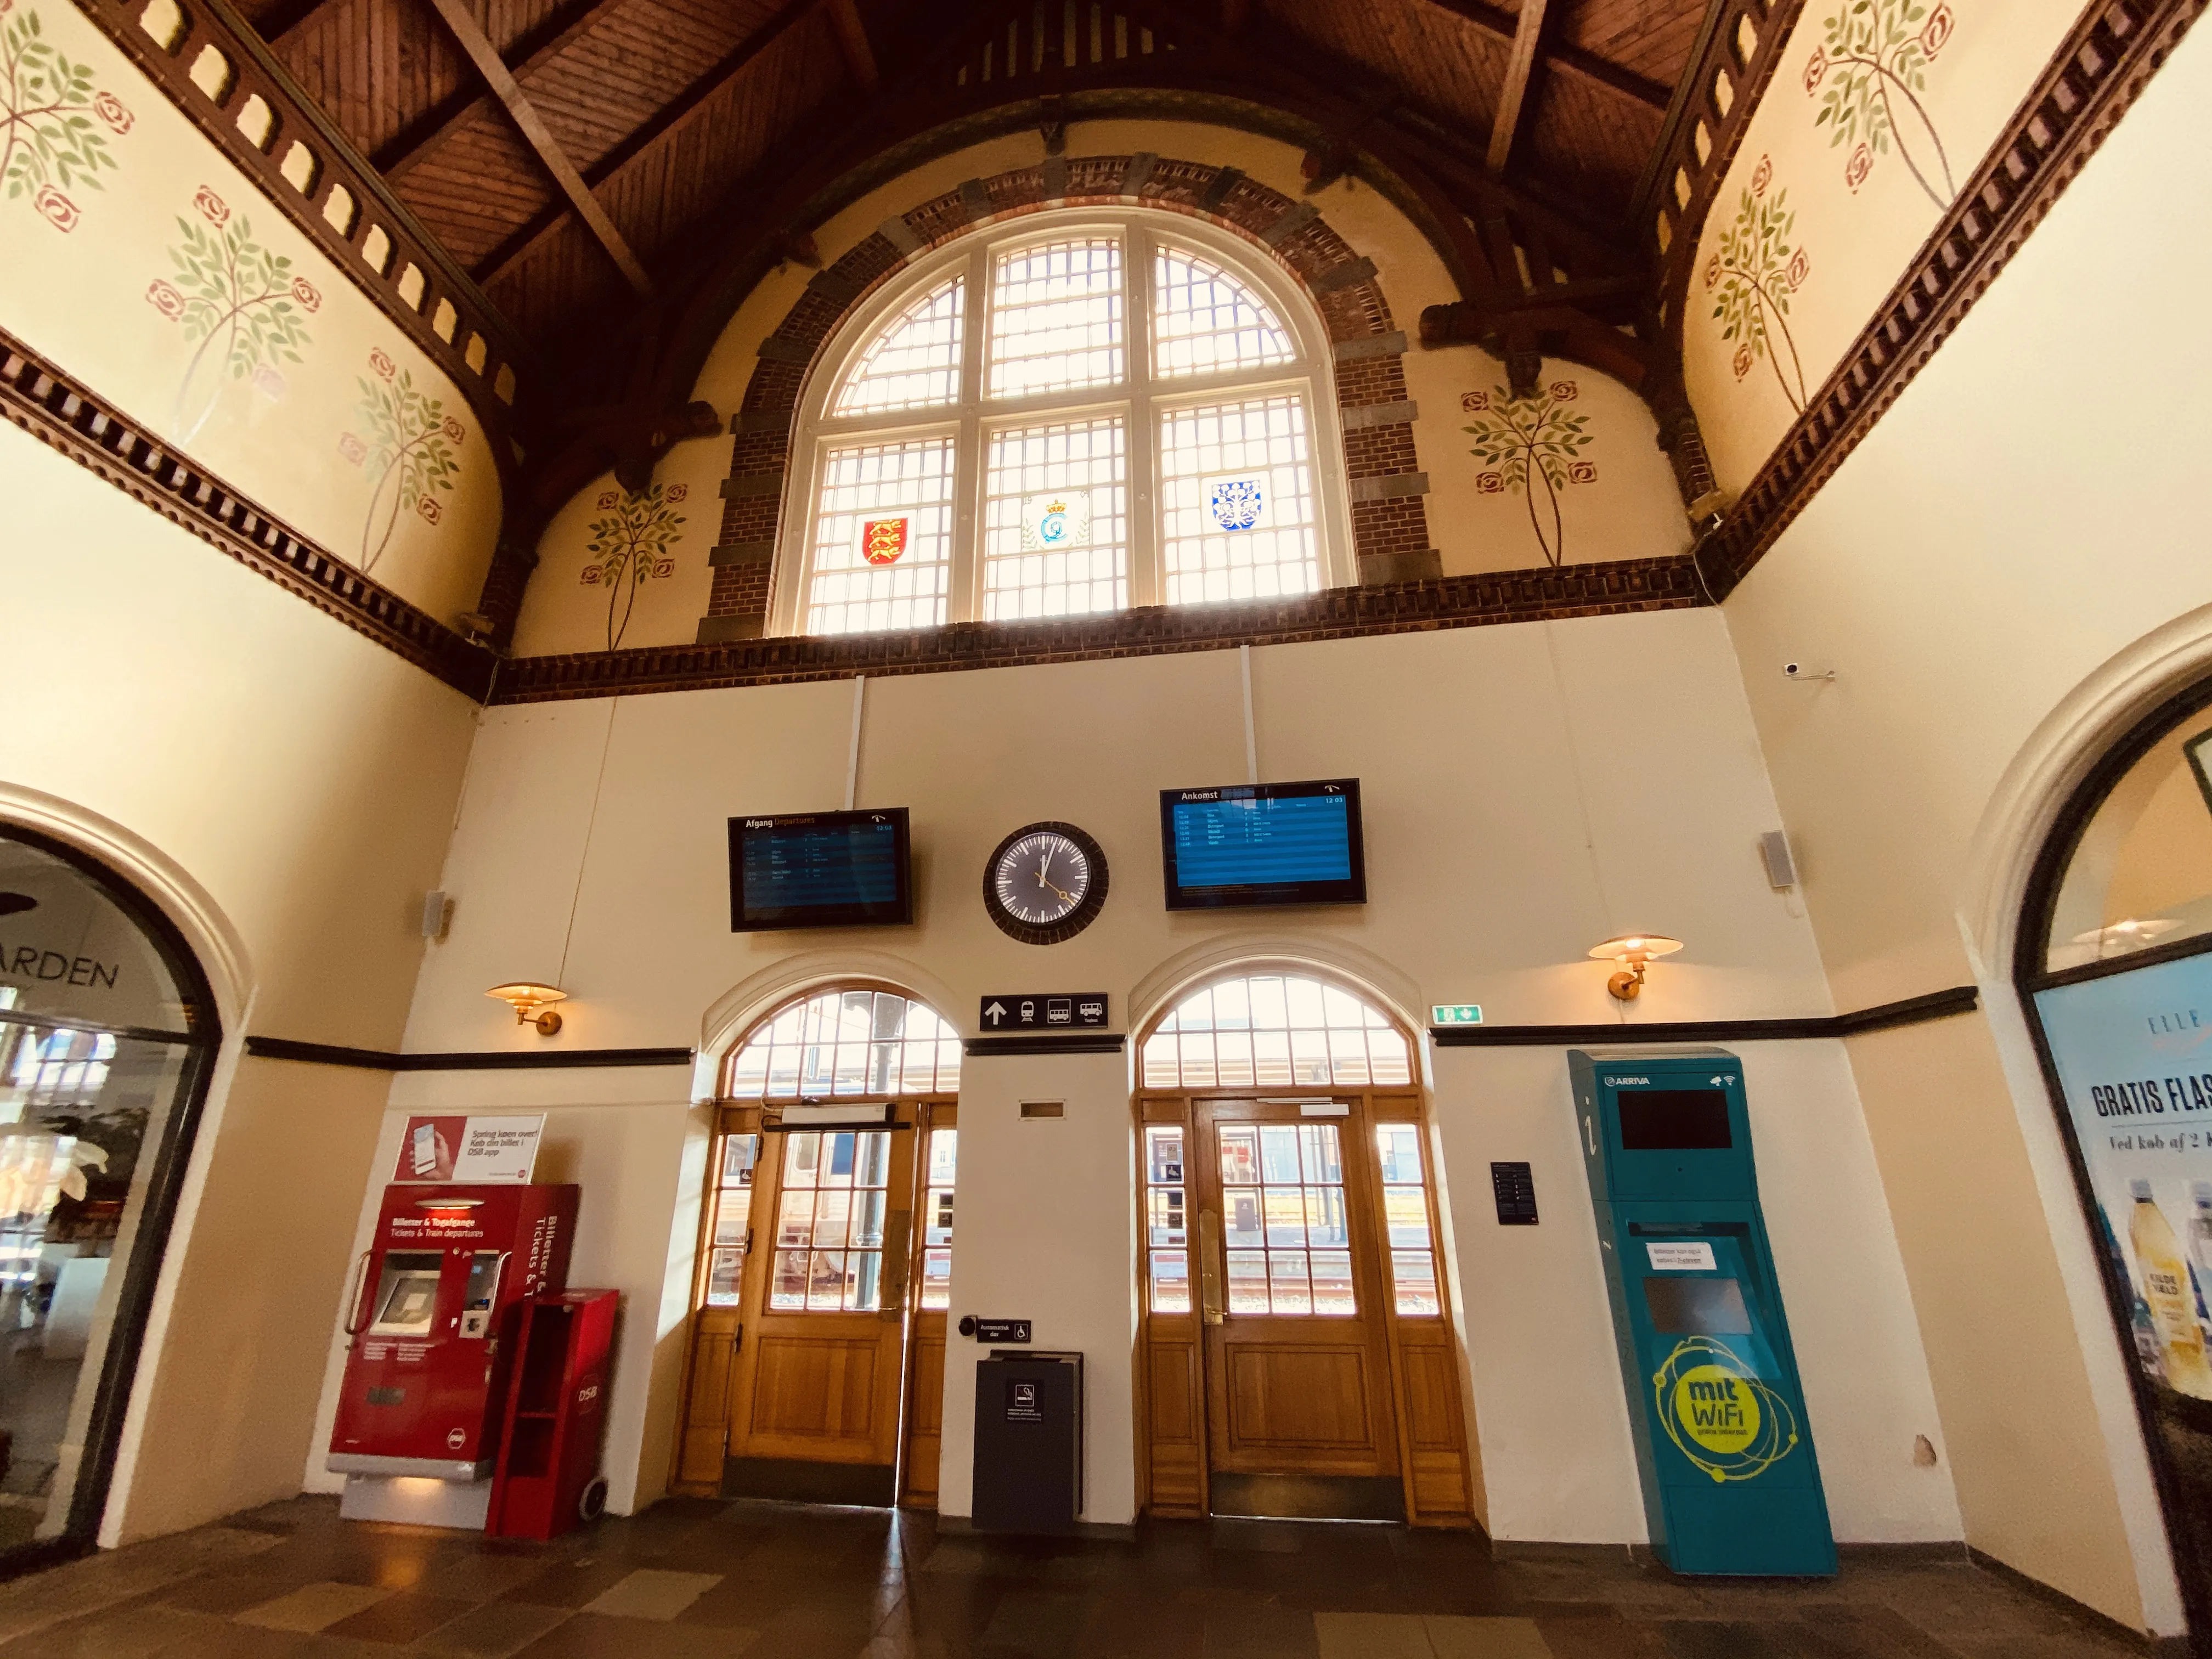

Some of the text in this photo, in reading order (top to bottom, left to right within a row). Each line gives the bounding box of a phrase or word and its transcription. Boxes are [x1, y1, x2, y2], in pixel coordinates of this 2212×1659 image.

[1181, 791, 1218, 800] Ankomst
[746, 817, 815, 829] Afgang Departures
[1616, 1077, 1650, 1085] ARRIVA
[2091, 1080, 2164, 1117] GRATIS
[472, 1130, 496, 1140] Spring
[2170, 1132, 2185, 1153] af
[2188, 1133, 2199, 1148] 2
[392, 1217, 476, 1227] Billetter & Togafgange
[391, 1228, 484, 1238] Tickets & Train departures
[529, 1216, 546, 1268] Tickets
[540, 1215, 557, 1277] Billetter
[526, 1273, 537, 1285] &
[578, 1386, 598, 1402] DSB
[1688, 1378, 1739, 1401] mit
